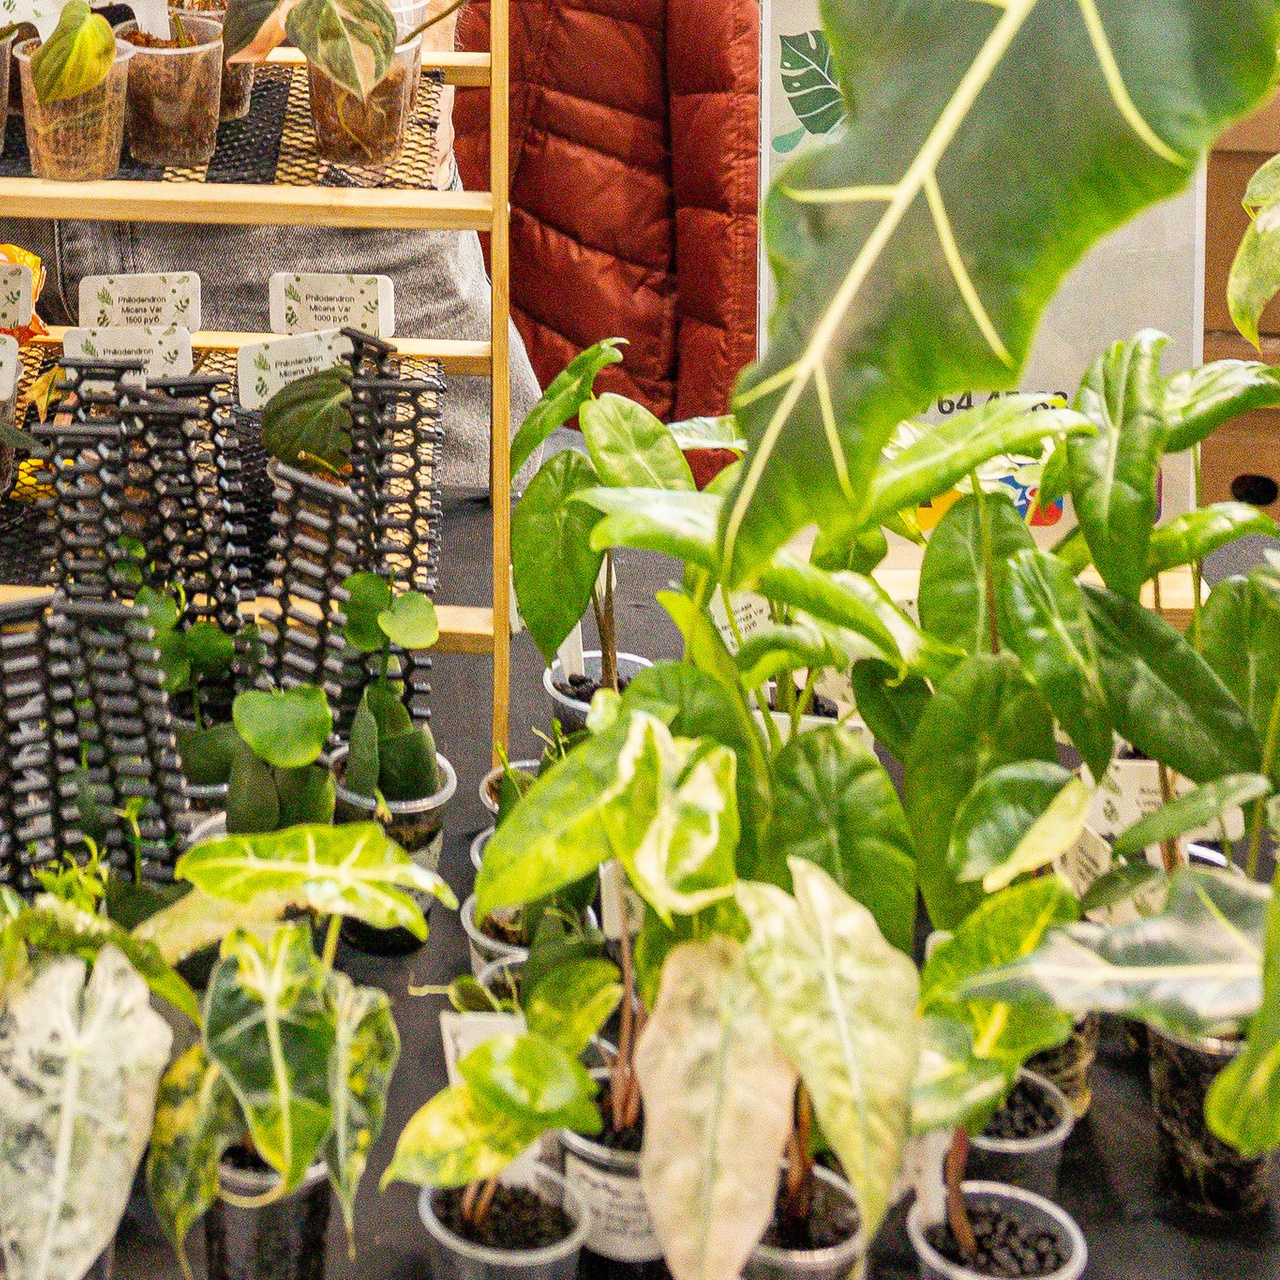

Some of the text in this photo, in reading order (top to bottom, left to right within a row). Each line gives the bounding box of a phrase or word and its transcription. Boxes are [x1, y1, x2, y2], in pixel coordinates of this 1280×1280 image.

[305, 294, 355, 302] Philodendron
[275, 355, 323, 368] Philodendron
[279, 368, 304, 378] Micans
